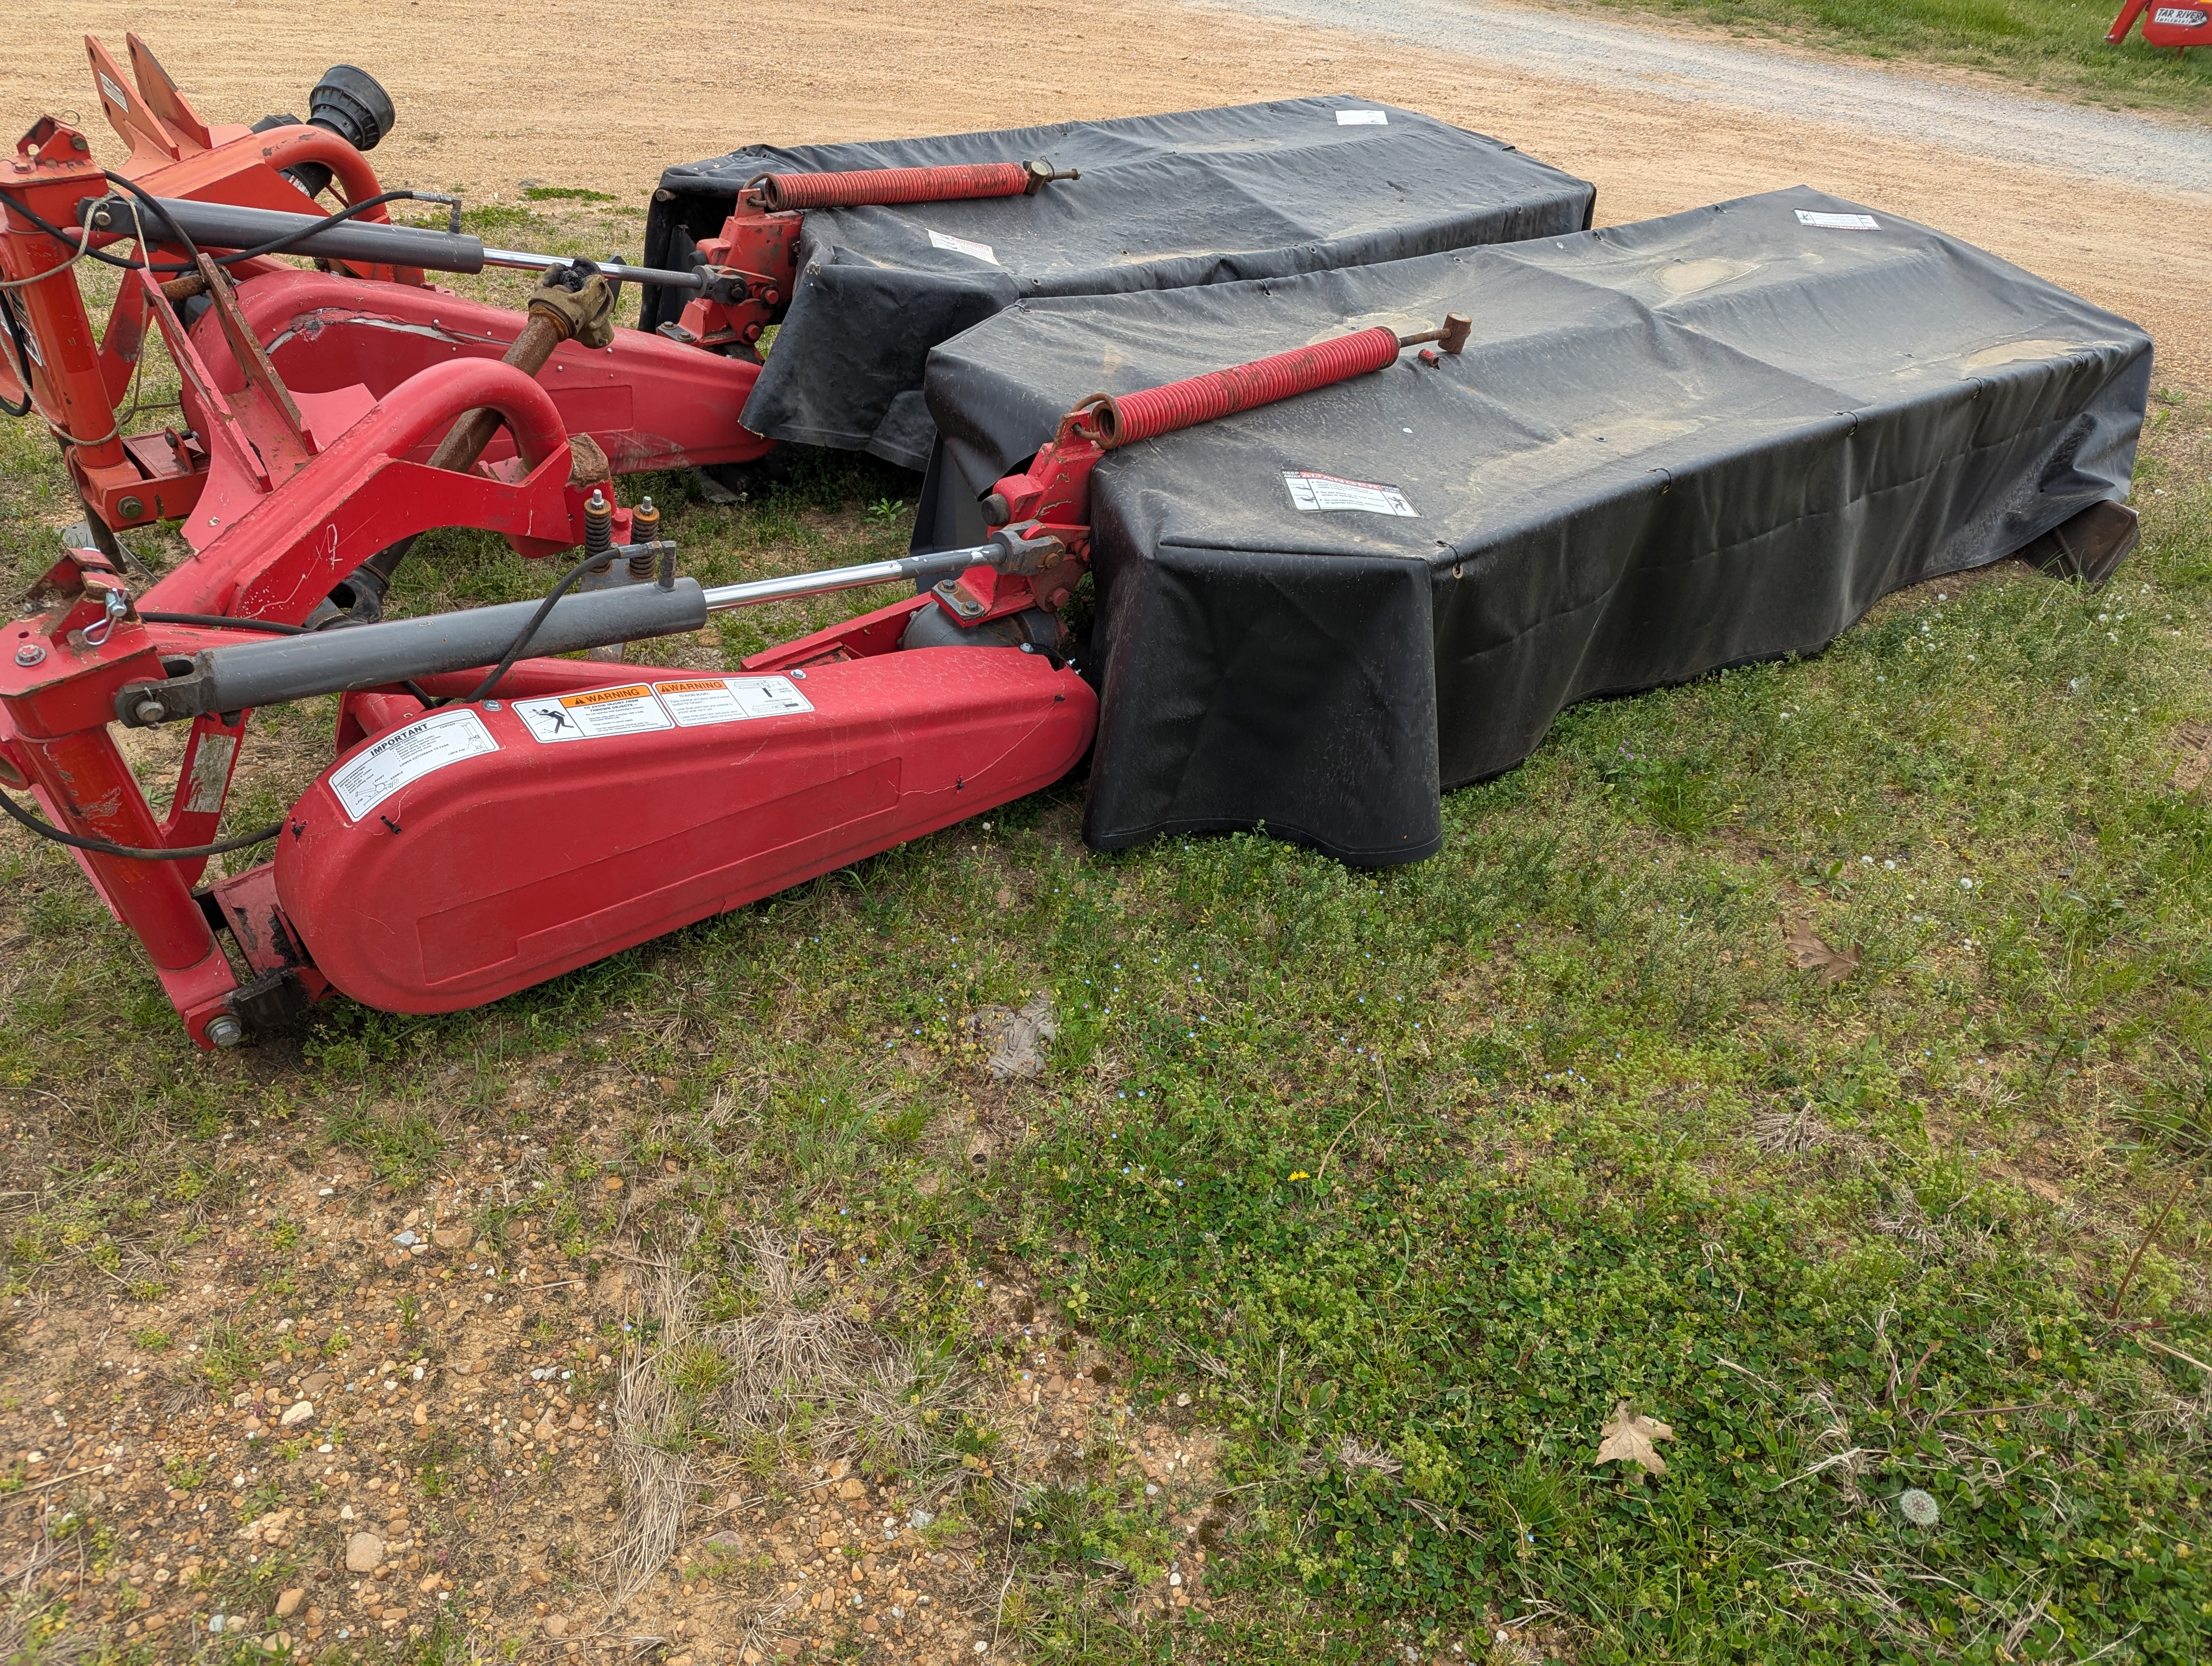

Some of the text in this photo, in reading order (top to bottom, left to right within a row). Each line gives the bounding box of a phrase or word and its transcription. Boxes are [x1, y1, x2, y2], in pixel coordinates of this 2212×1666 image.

[2158, 9, 2203, 20] TAR RIVER
[1311, 473, 1380, 490] DANGER
[670, 682, 723, 691] WARNING
[586, 689, 640, 702] WARNING
[370, 723, 428, 757] IMPORTANT
[400, 759, 412, 767] LOWER
[412, 749, 433, 760] CUTTERBAR
[375, 774, 384, 783] PIVOT
[390, 771, 403, 780] SADDLE
